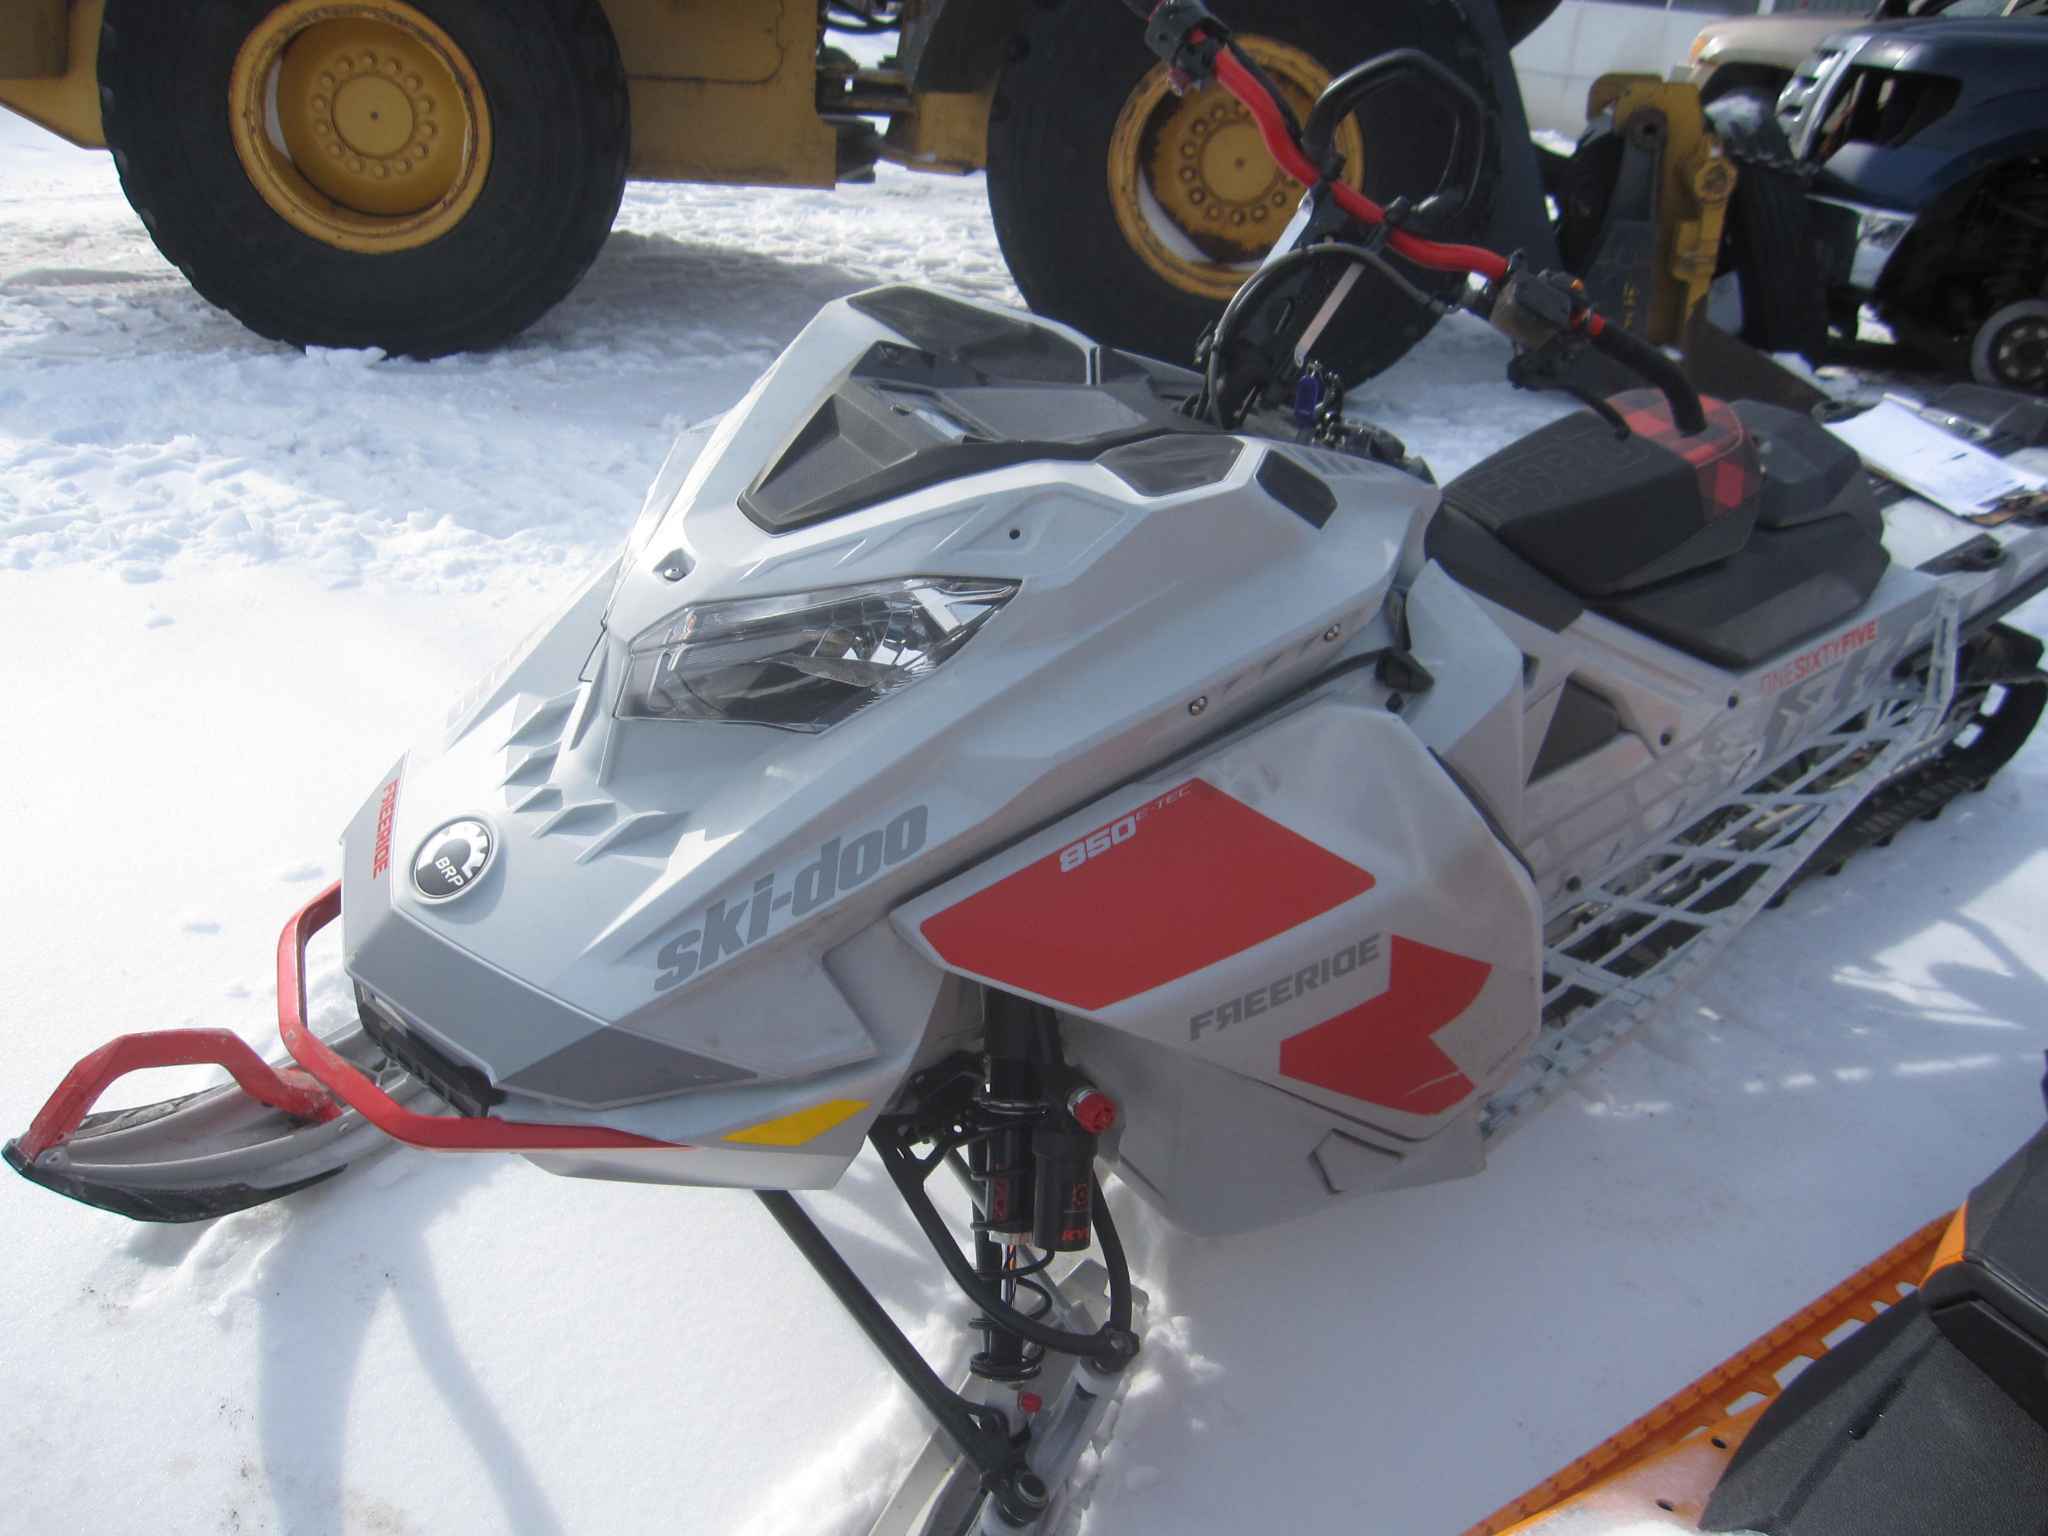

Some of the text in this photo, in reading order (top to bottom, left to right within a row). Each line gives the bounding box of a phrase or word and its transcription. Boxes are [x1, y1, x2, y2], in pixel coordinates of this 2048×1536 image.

[435, 856, 464, 886] BRP
[1059, 815, 1137, 872] 850
[1188, 932, 1380, 1041] FREERIDE
